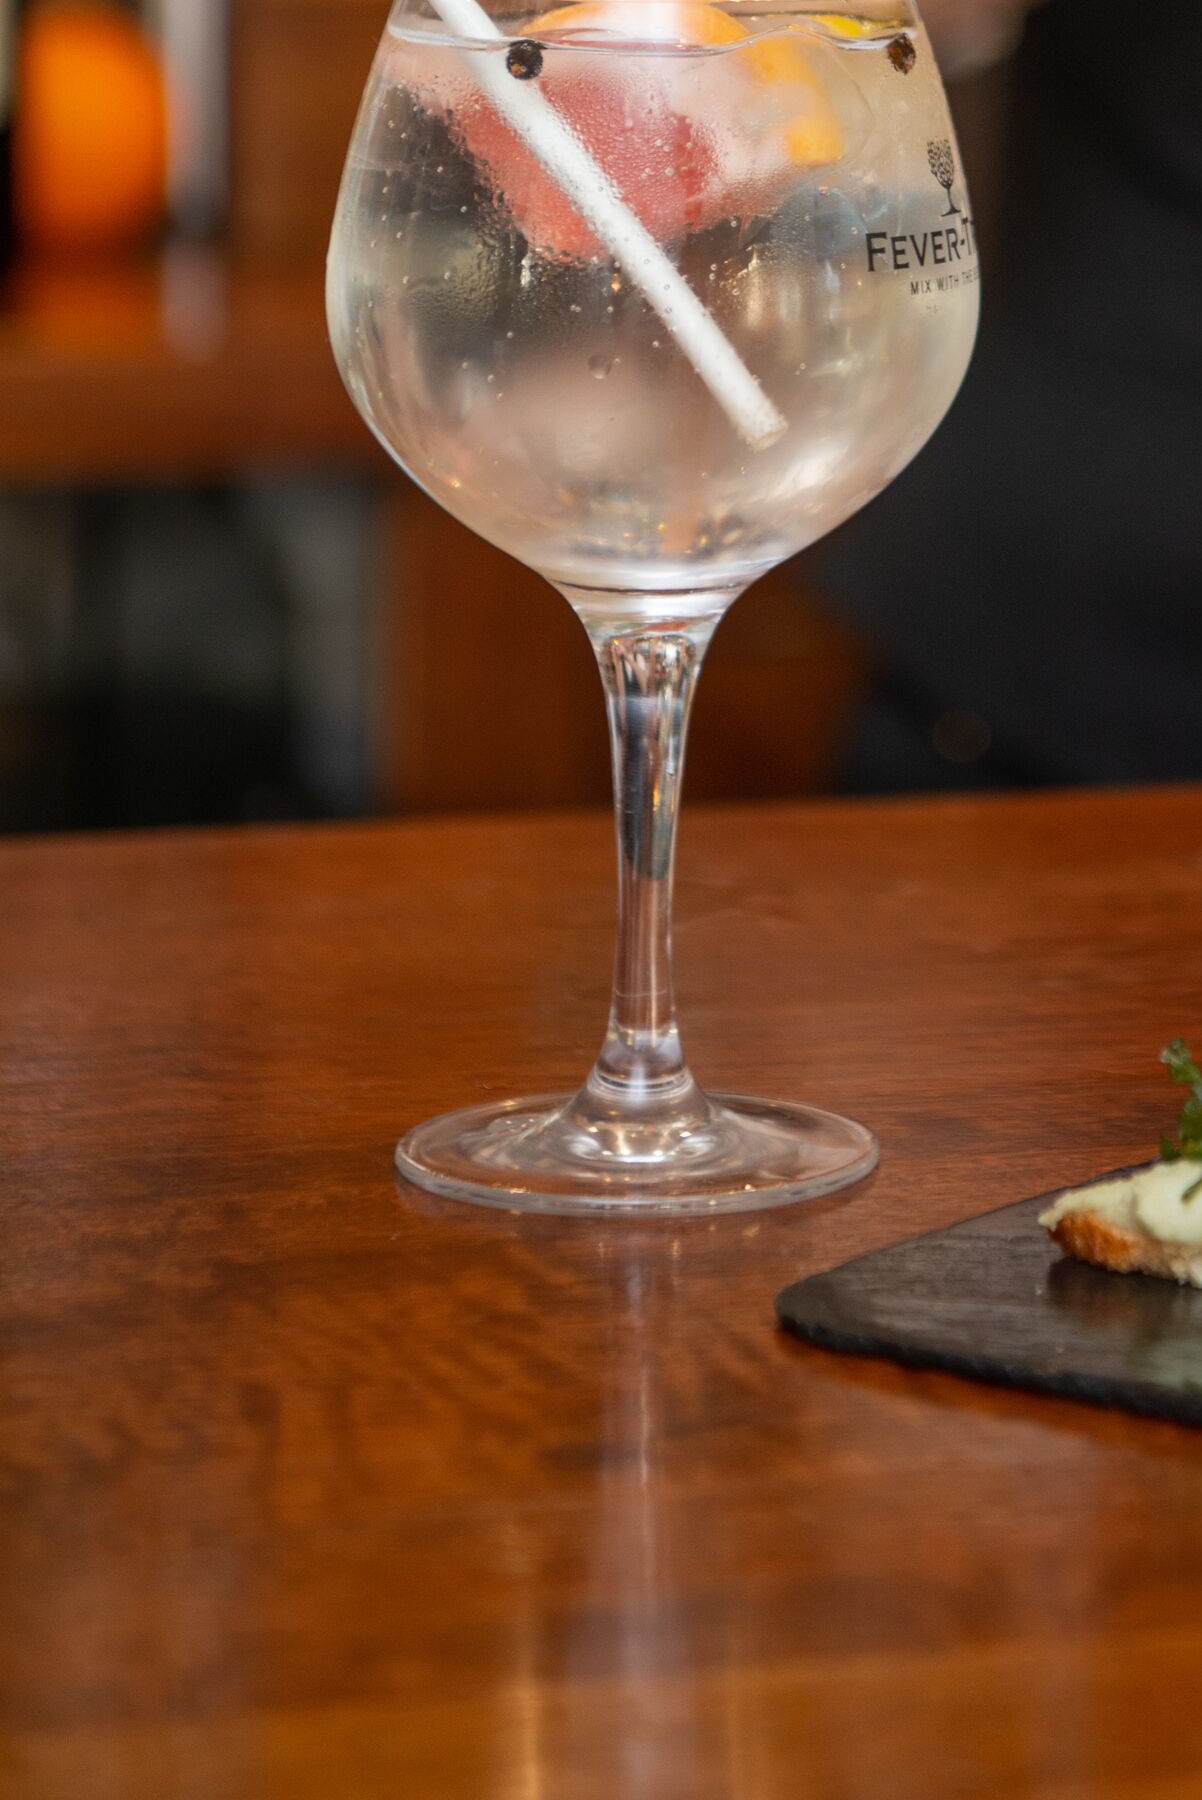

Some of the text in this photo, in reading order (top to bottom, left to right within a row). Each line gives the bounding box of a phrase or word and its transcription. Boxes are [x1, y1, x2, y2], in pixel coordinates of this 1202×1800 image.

[865, 216, 977, 272] FEVER-T
[910, 280, 931, 296] MIX
[936, 274, 959, 291] WITH
